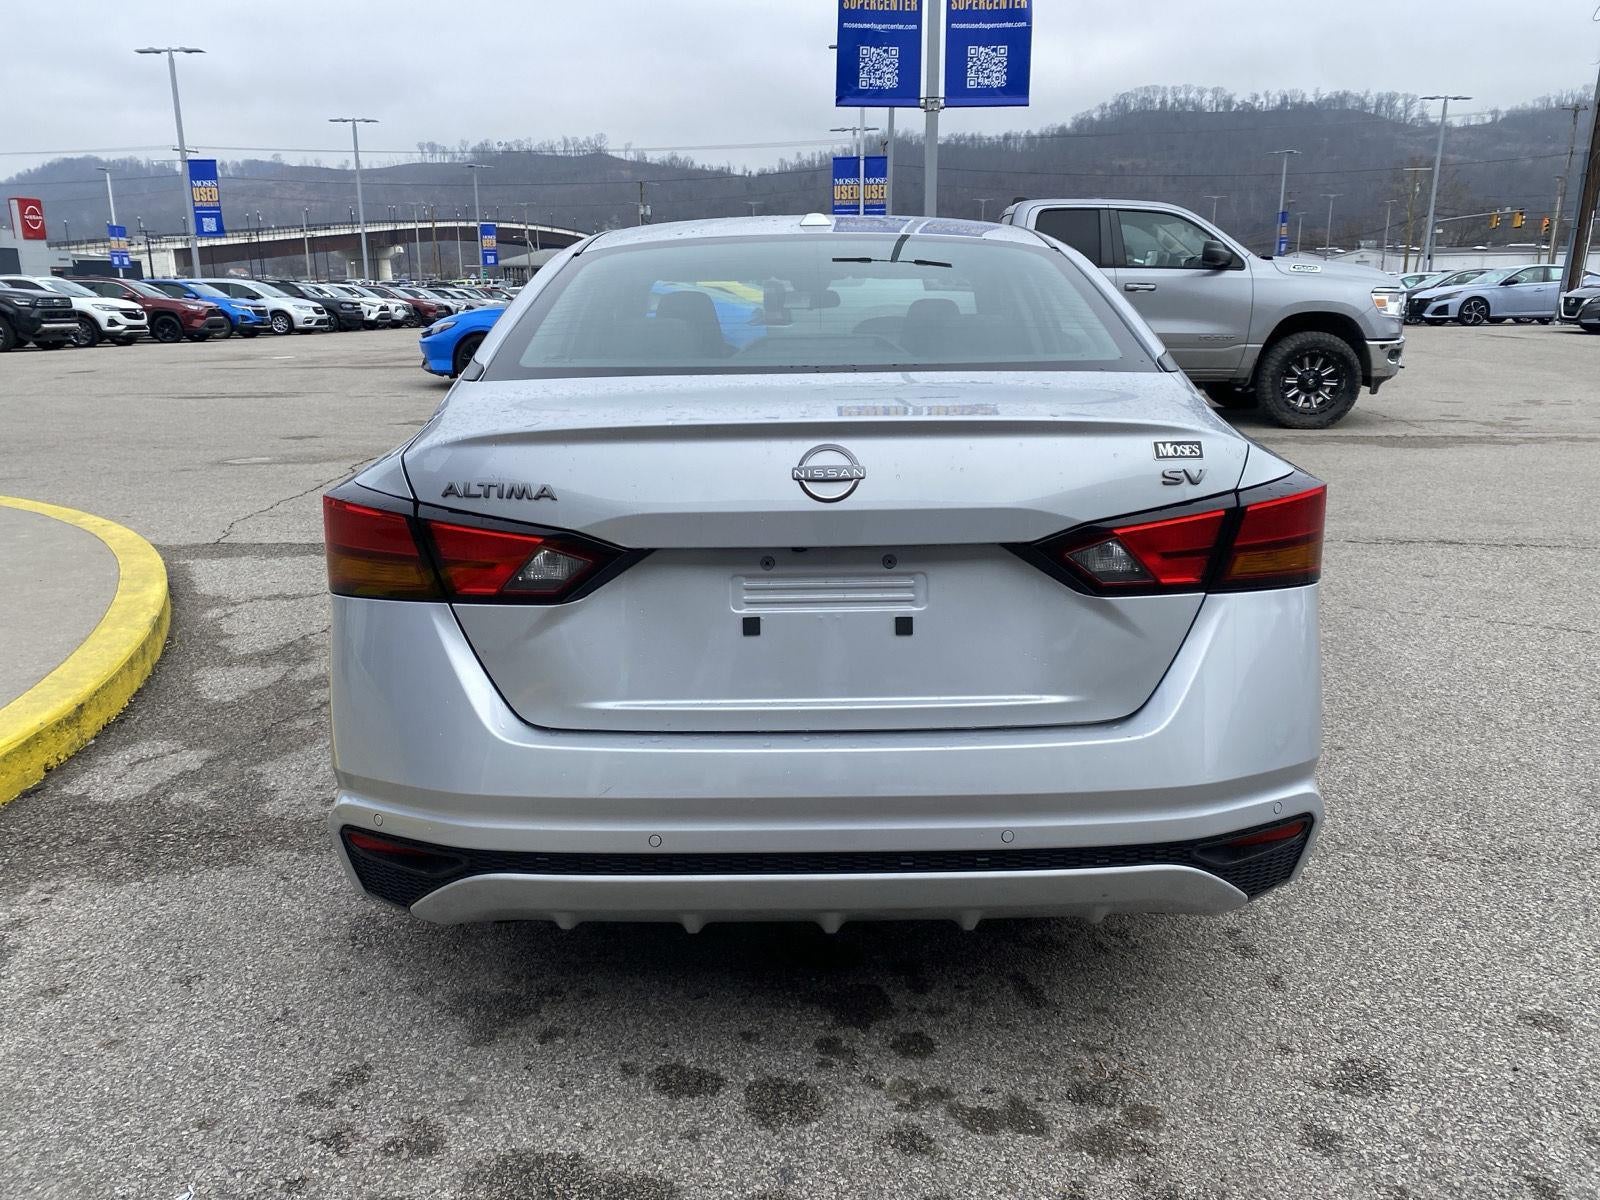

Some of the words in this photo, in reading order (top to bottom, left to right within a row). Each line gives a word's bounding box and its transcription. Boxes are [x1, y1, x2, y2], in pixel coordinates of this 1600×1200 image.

[843, 22, 918, 31] mosesusedsupercenter.com
[951, 21, 1027, 30] mosesusedsupercenter.com
[192, 187, 219, 202] USED
[834, 185, 860, 200] USED
[794, 466, 865, 479] NISSAN
[1161, 468, 1207, 486] SV
[440, 480, 558, 501] ALTIMA
